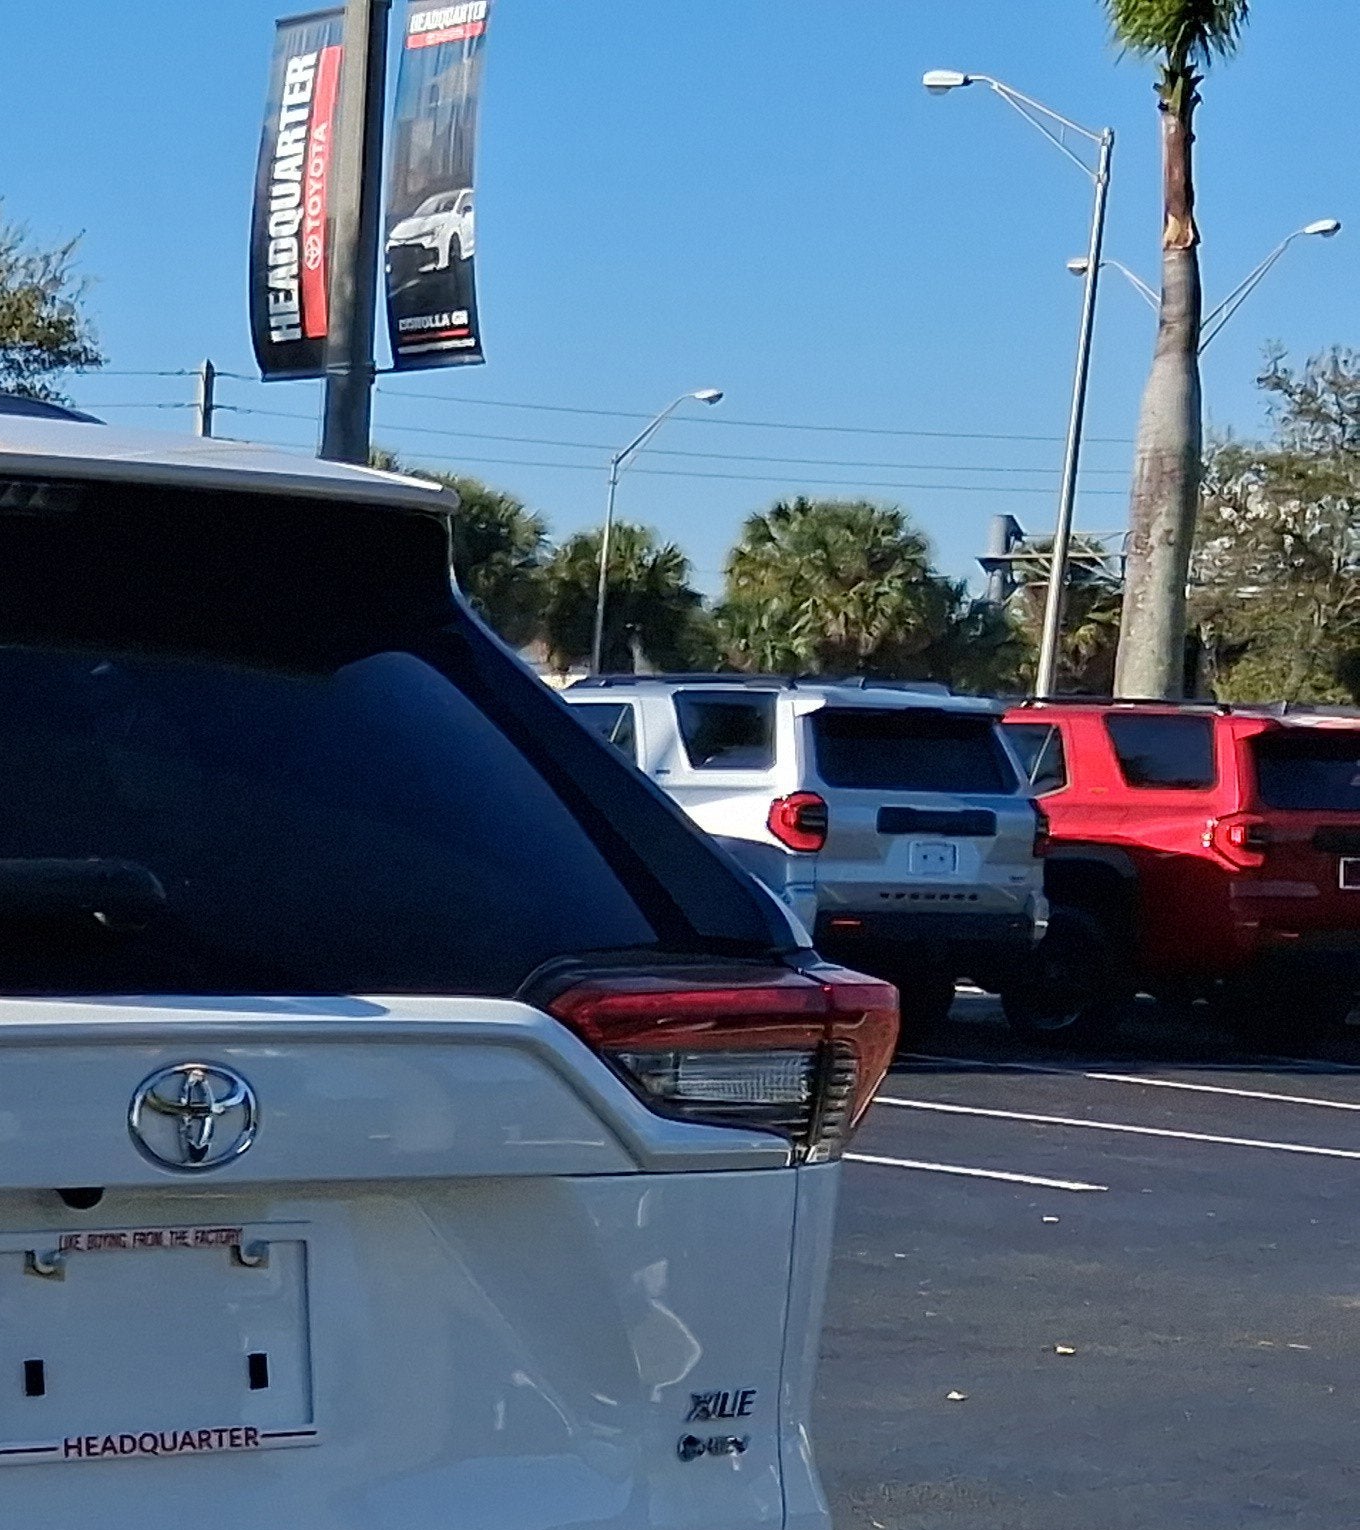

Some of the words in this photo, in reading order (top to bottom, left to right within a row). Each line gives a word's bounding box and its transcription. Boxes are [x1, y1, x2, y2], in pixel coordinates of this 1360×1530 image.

[267, 51, 318, 343] HEADQUARTER
[306, 122, 328, 232] TOYOTA
[63, 1426, 260, 1458] HEADQUARTER
